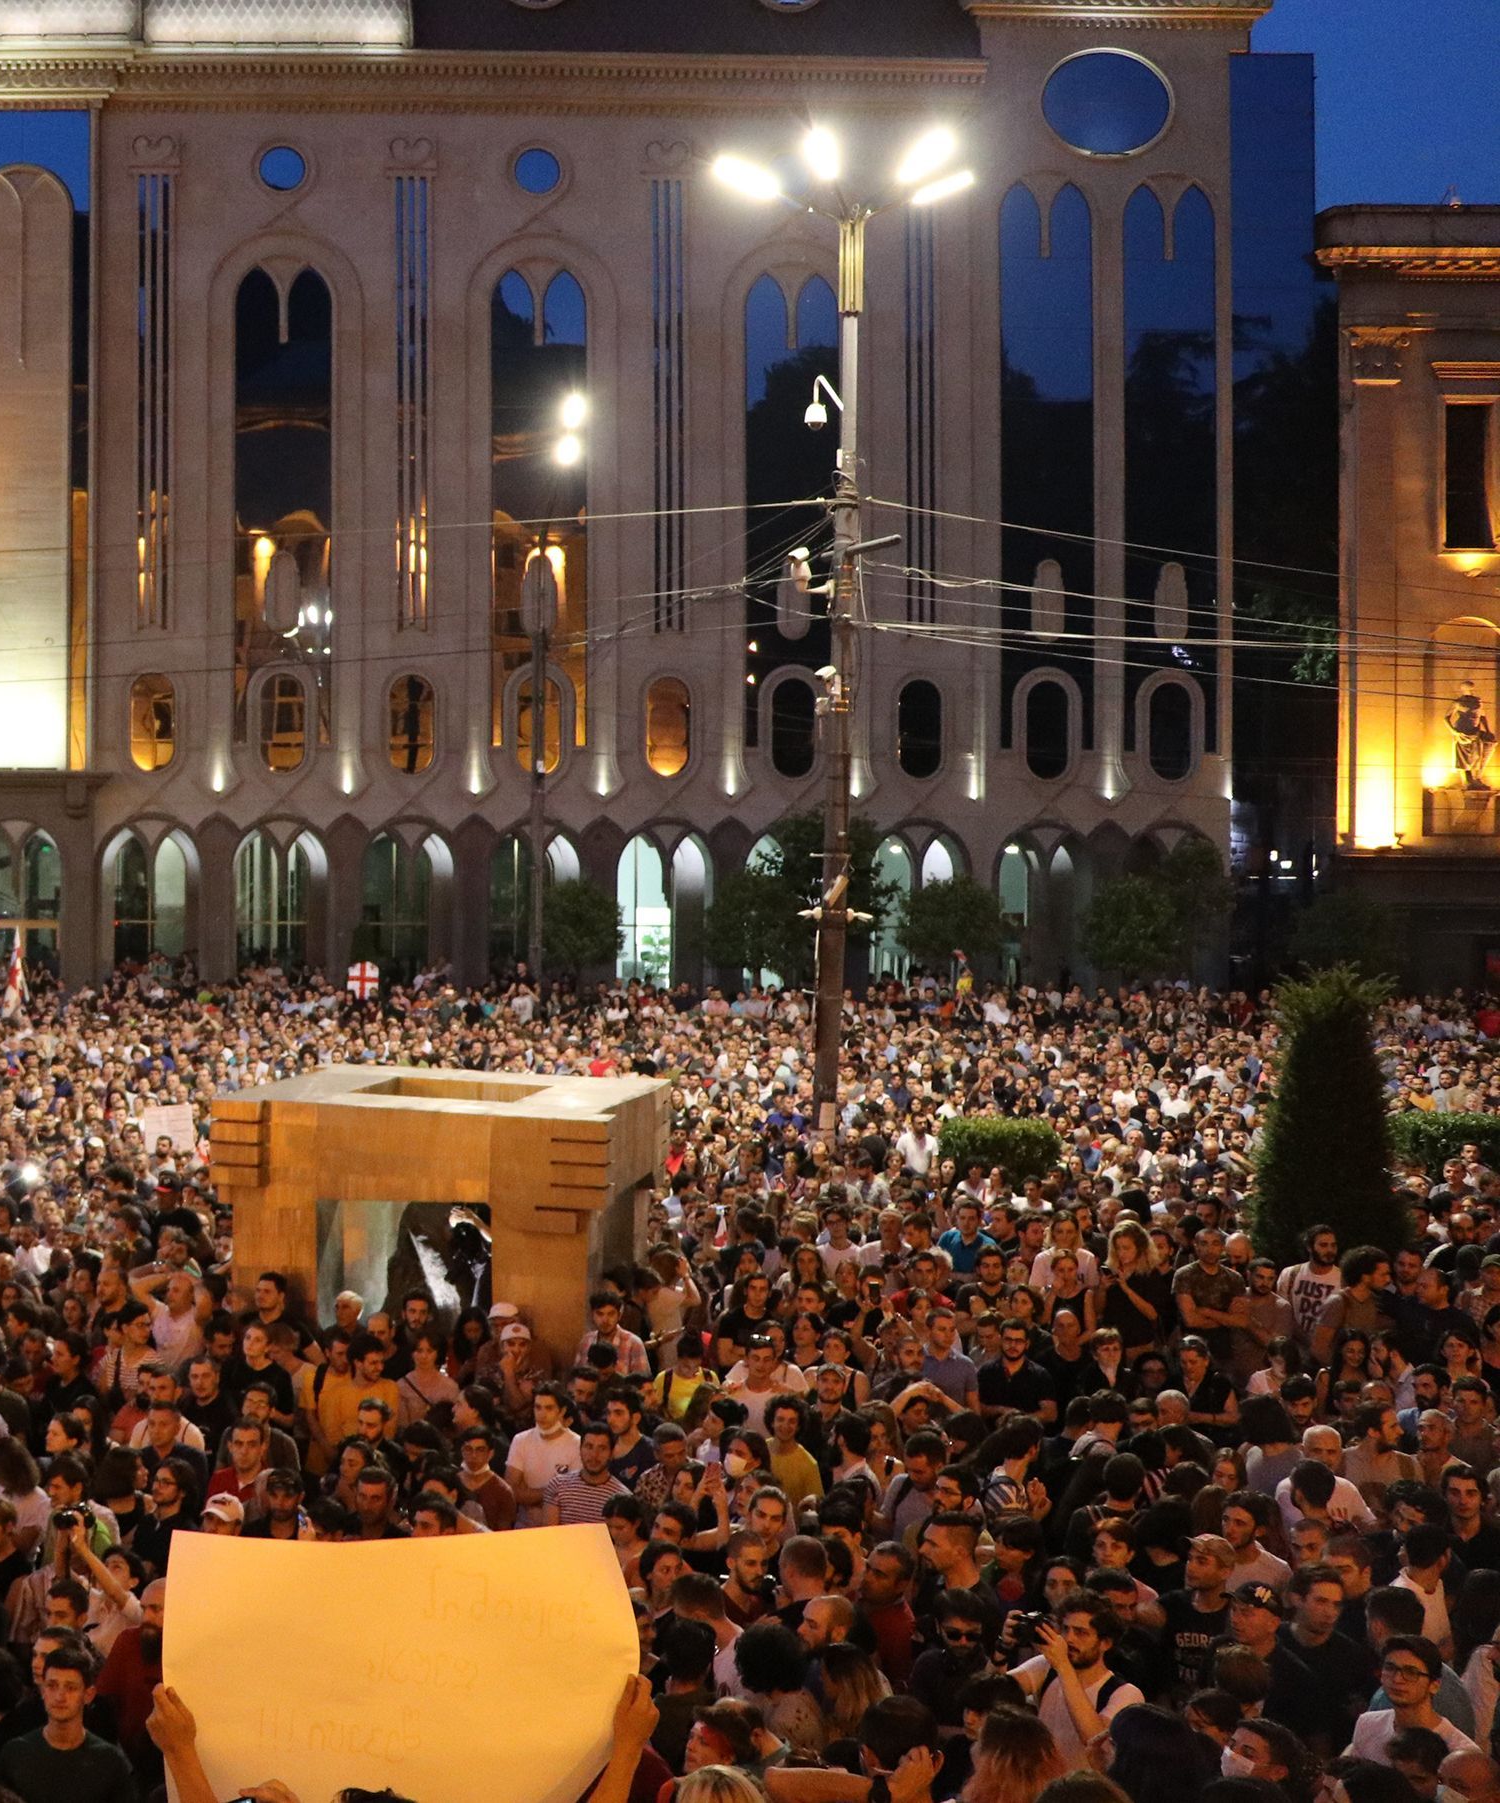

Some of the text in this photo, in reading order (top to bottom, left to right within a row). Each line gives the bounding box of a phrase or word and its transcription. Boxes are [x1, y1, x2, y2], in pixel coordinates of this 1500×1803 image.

[1294, 1280, 1335, 1299] JUST
[1301, 1315, 1316, 1332] IT
[1175, 1632, 1211, 1649] GEOR
